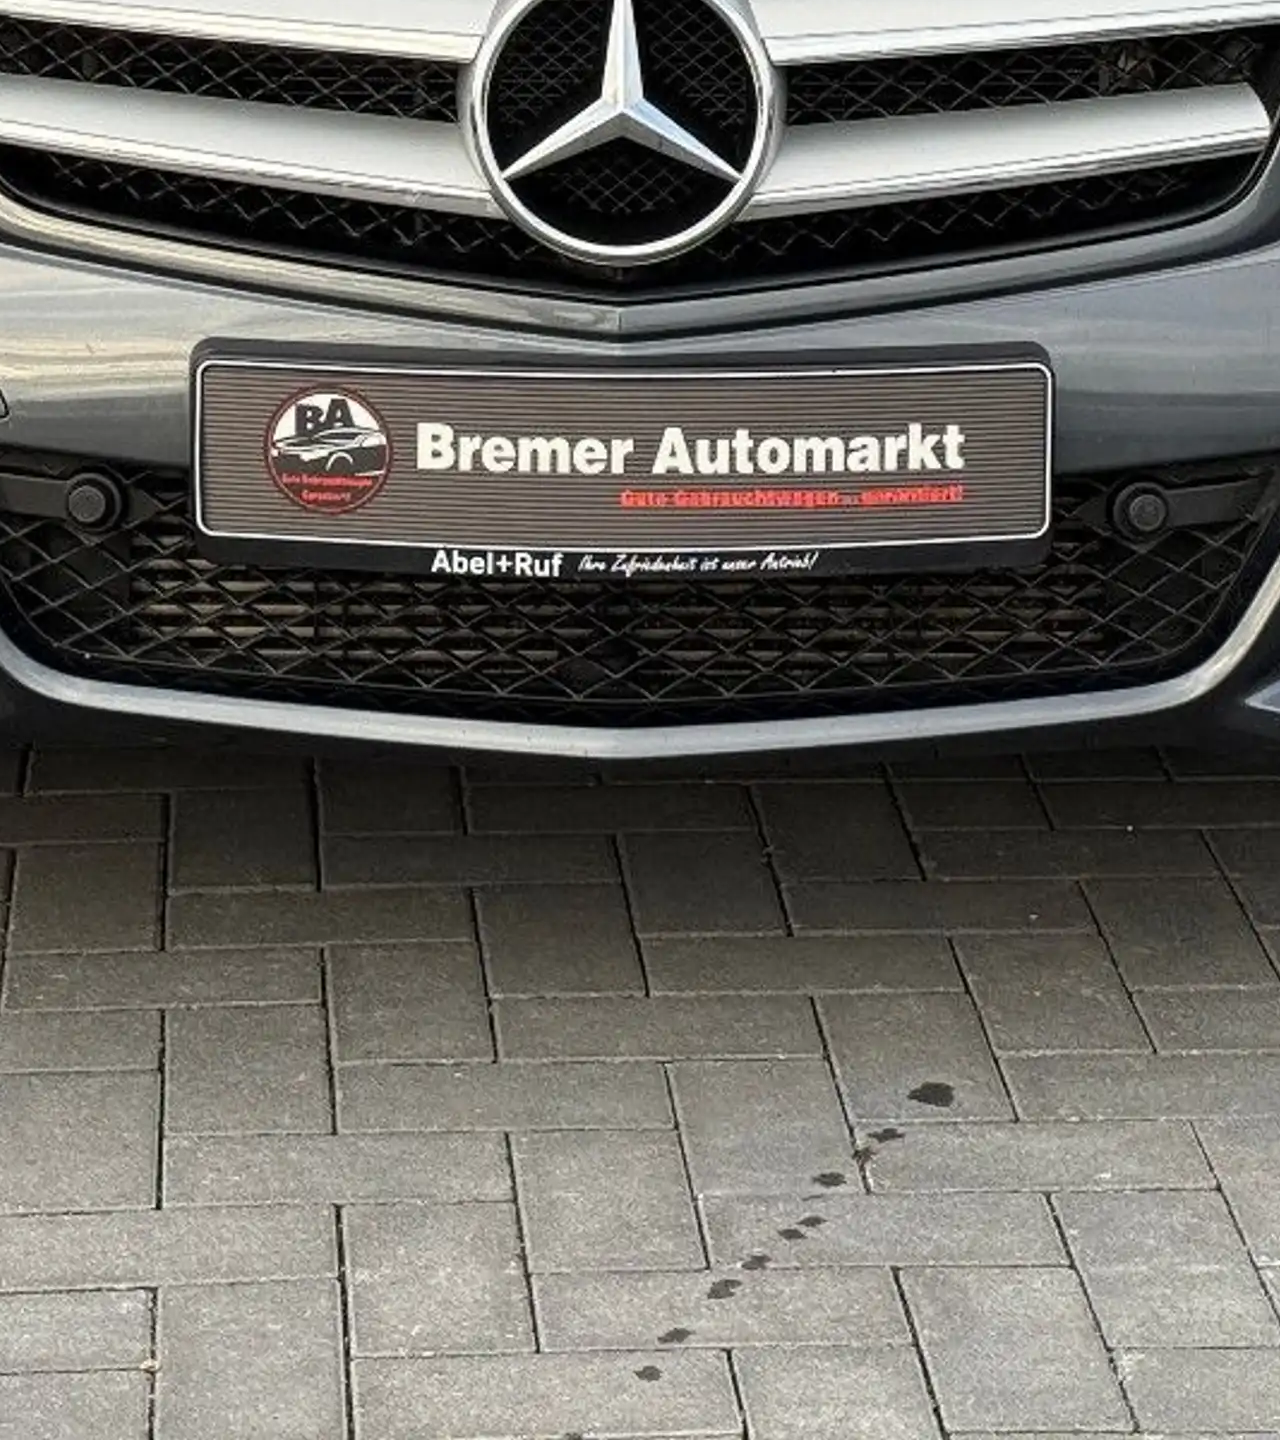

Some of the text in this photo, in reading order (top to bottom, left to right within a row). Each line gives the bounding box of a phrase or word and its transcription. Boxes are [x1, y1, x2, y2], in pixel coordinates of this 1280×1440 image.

[294, 398, 355, 437] BA
[416, 422, 966, 475] Bremer Automarkt
[431, 549, 564, 578] Abel+Ruf
[577, 550, 819, 578] Ihre Zufriedenheit ist unser Antrieb!
